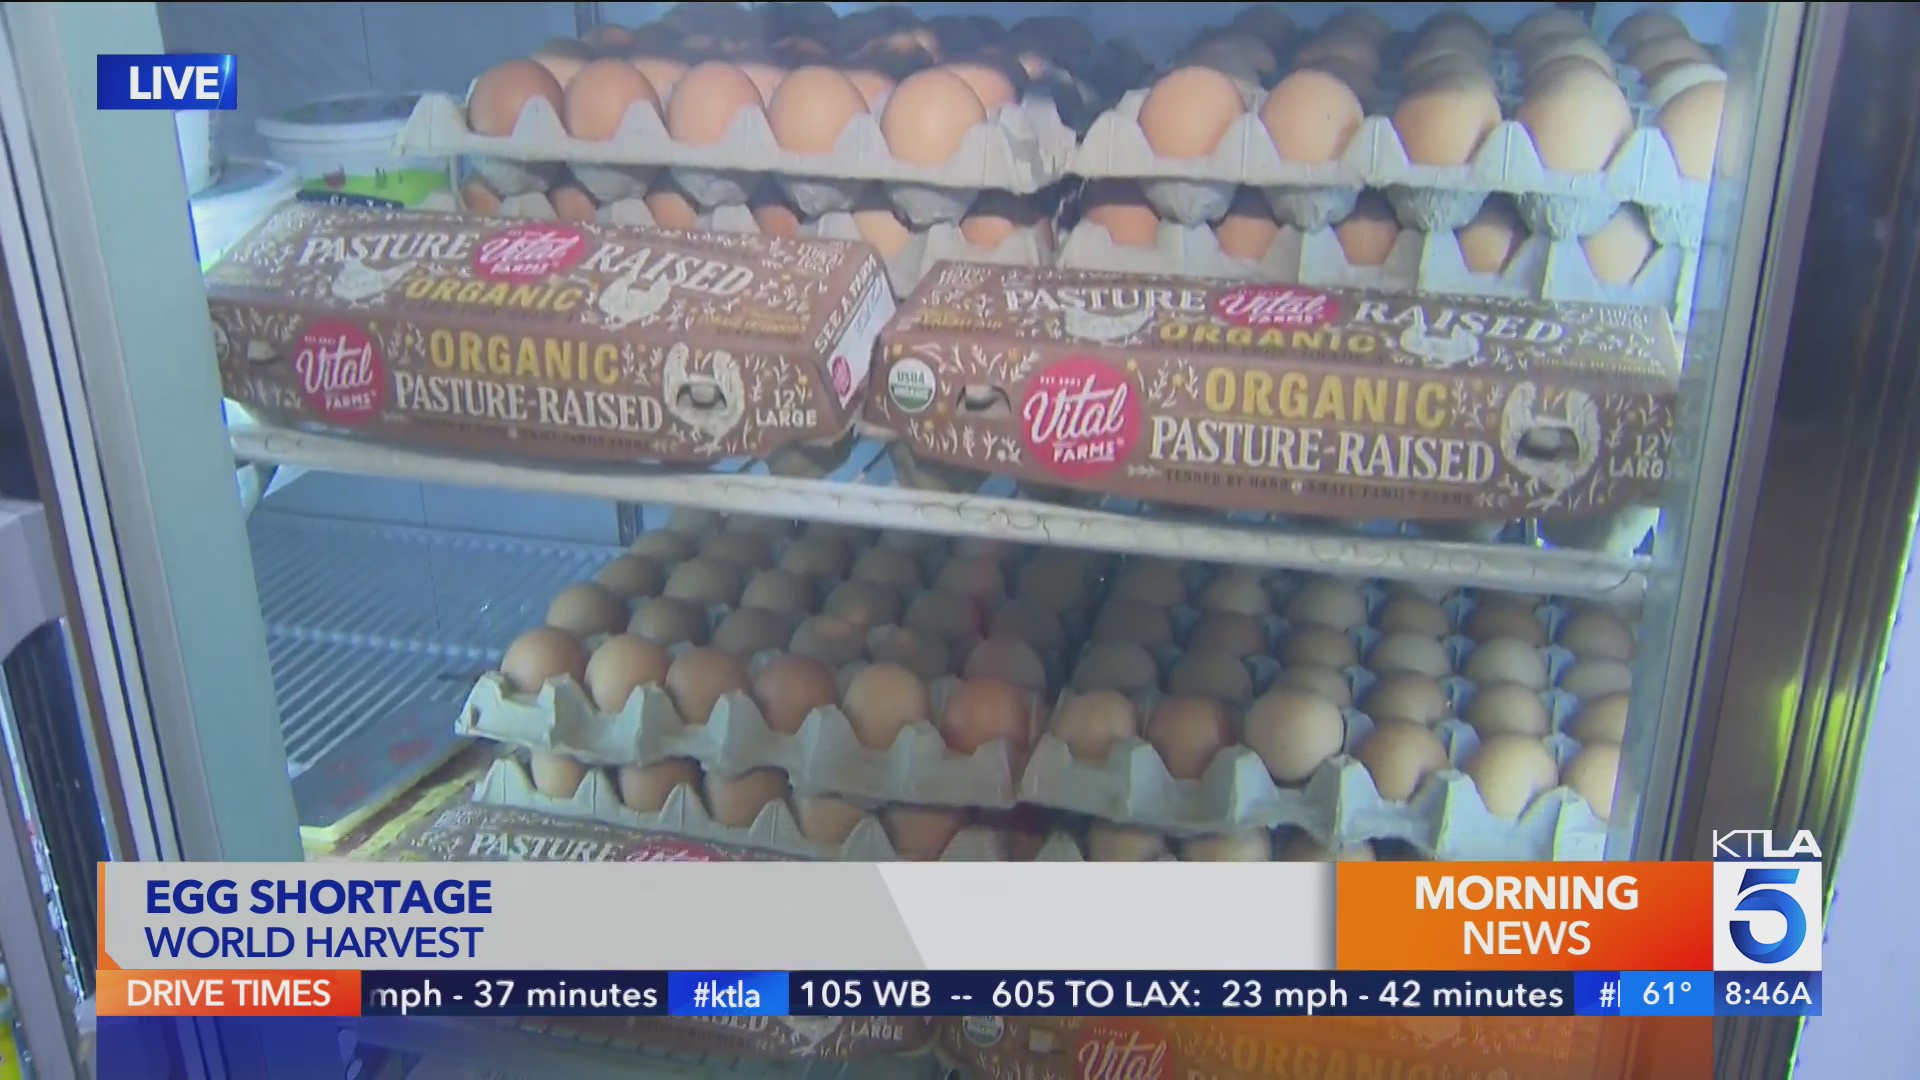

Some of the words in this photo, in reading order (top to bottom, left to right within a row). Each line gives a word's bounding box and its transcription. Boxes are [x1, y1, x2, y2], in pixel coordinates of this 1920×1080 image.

[298, 232, 480, 265] PASTURE
[580, 242, 755, 296] RAISED
[405, 277, 583, 311] ORGANIC
[1219, 290, 1327, 316] Vital
[1005, 288, 1206, 311] PASTURE
[1353, 301, 1566, 343] RAISED
[430, 328, 620, 385] ORGANIC
[1159, 325, 1378, 354] ORGANIC
[295, 334, 374, 395] Vital
[393, 371, 665, 432] PASTURE-RAISED
[755, 408, 817, 428] LARGE
[773, 389, 796, 411] 12
[1023, 373, 1128, 445] Vital
[1205, 366, 1449, 429] ORGANIC
[1053, 440, 1116, 463] FARMS
[1149, 415, 1496, 484] PASTURE-RAISED
[1633, 433, 1660, 457] 12
[468, 832, 624, 862] PASTURE
[851, 1019, 904, 1041] LARGE
[1079, 1030, 1167, 1080] Vital
